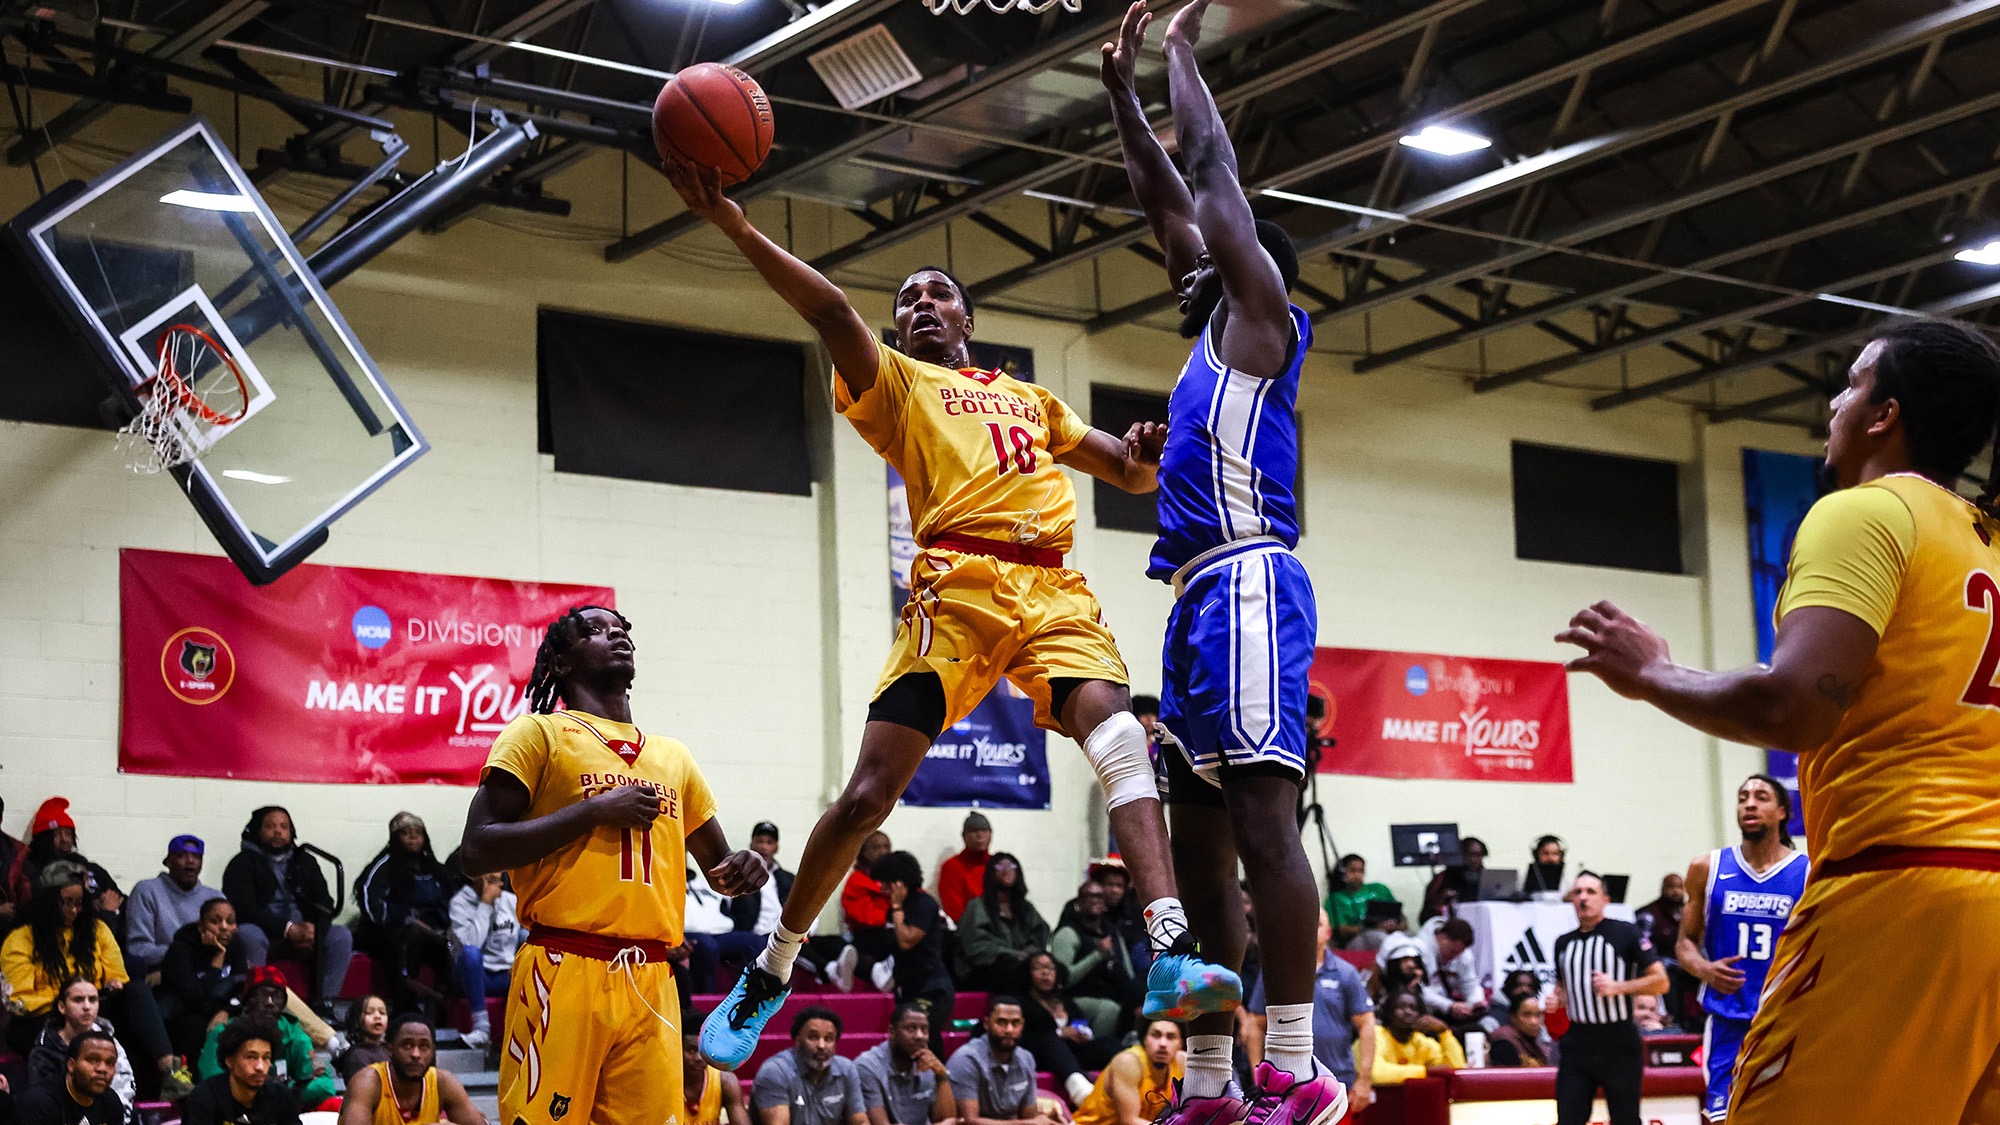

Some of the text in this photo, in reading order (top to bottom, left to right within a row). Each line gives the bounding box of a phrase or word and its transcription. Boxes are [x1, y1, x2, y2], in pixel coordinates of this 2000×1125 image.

[944, 399, 1046, 429] COLLEGE
[982, 422, 1037, 477] 10
[408, 618, 543, 648] DIVISION II
[305, 664, 533, 734] MAKE IT YOU
[1381, 706, 1540, 757] MAKE IT YOURS
[959, 744, 975, 759] IT
[973, 735, 1027, 767] YOURS
[619, 827, 653, 886] 11
[1725, 893, 1792, 917] BOBCATS
[1738, 922, 1772, 960] 13
